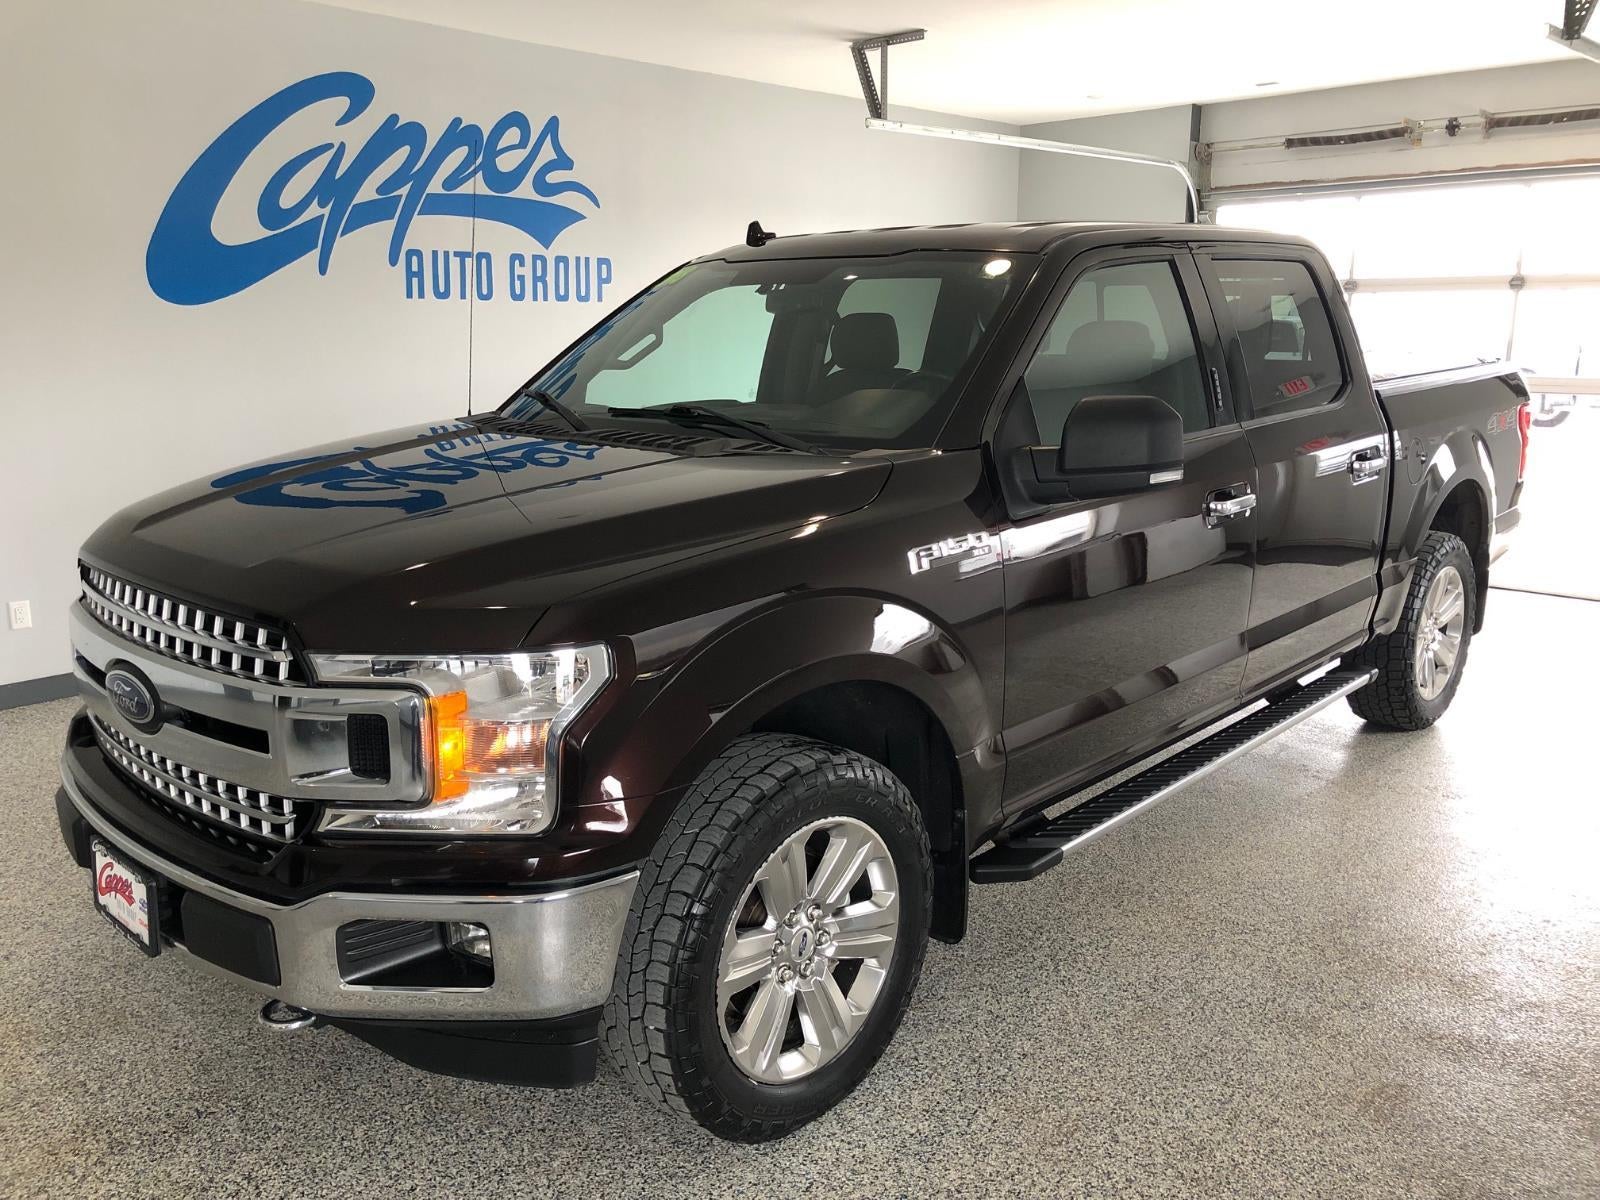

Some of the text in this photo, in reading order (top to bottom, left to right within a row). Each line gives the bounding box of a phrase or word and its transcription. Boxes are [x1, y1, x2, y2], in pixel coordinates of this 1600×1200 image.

[146, 71, 600, 306] Cappes
[405, 248, 613, 303] AUTO GROUP
[972, 545, 990, 558] XLT
[113, 680, 138, 714] Ford
